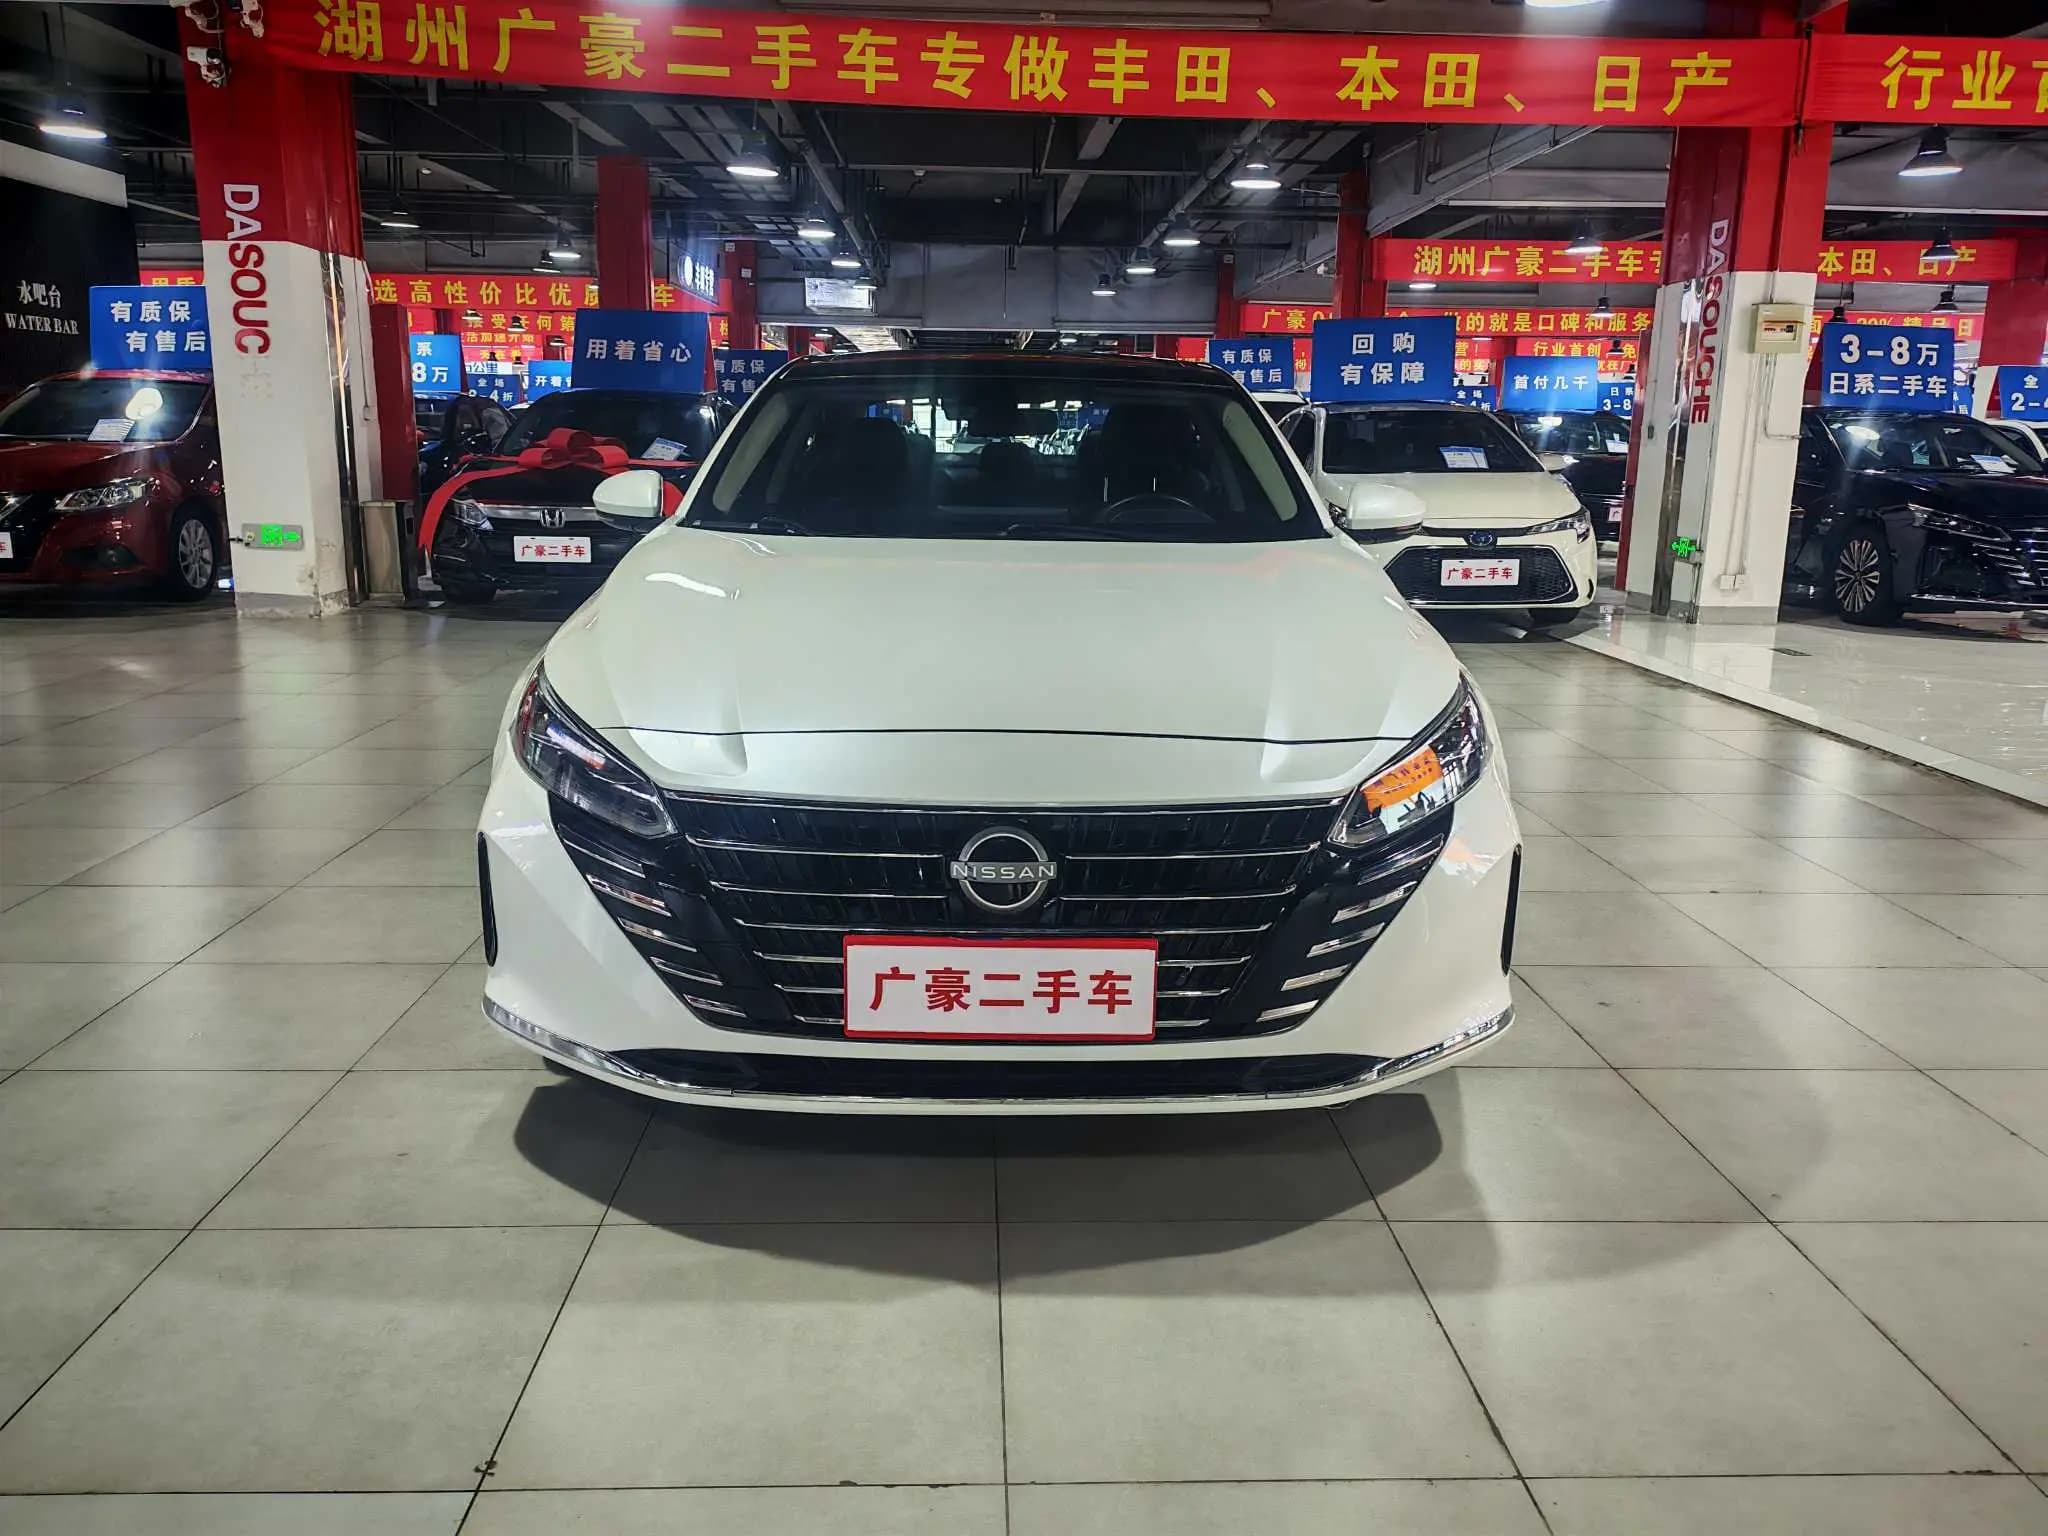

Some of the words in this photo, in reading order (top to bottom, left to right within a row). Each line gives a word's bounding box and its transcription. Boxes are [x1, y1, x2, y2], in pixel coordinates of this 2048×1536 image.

[314, 0, 1733, 114] 湖州广豪二手车专做丰田、本田、日产
[1880, 45, 2048, 114] 行业
[223, 183, 271, 354] DASOUC
[1817, 246, 1977, 277] 本田、日产
[16, 280, 61, 308] 水吧台
[110, 300, 191, 322] 有质保
[1691, 218, 1729, 424] DASOUCHE
[5, 313, 52, 332] WATER
[53, 318, 80, 335] BAR
[126, 331, 206, 353] 有售后
[586, 338, 692, 363] 用着省心
[1352, 332, 1415, 355] 回购
[1840, 333, 1940, 366] 3-8万
[714, 359, 765, 374] 有质保
[1222, 348, 1272, 364] 有质保
[1232, 368, 1282, 383] 有售后
[1340, 362, 1425, 385] 有保障
[1514, 375, 1590, 391] 首付几千
[1830, 371, 1947, 398] 日系二手车
[520, 544, 586, 558] 广豪二手车
[1447, 566, 1513, 581] 广豪二手车
[952, 862, 1056, 880] NISSAN
[868, 965, 1133, 1015] 广豪二手车
